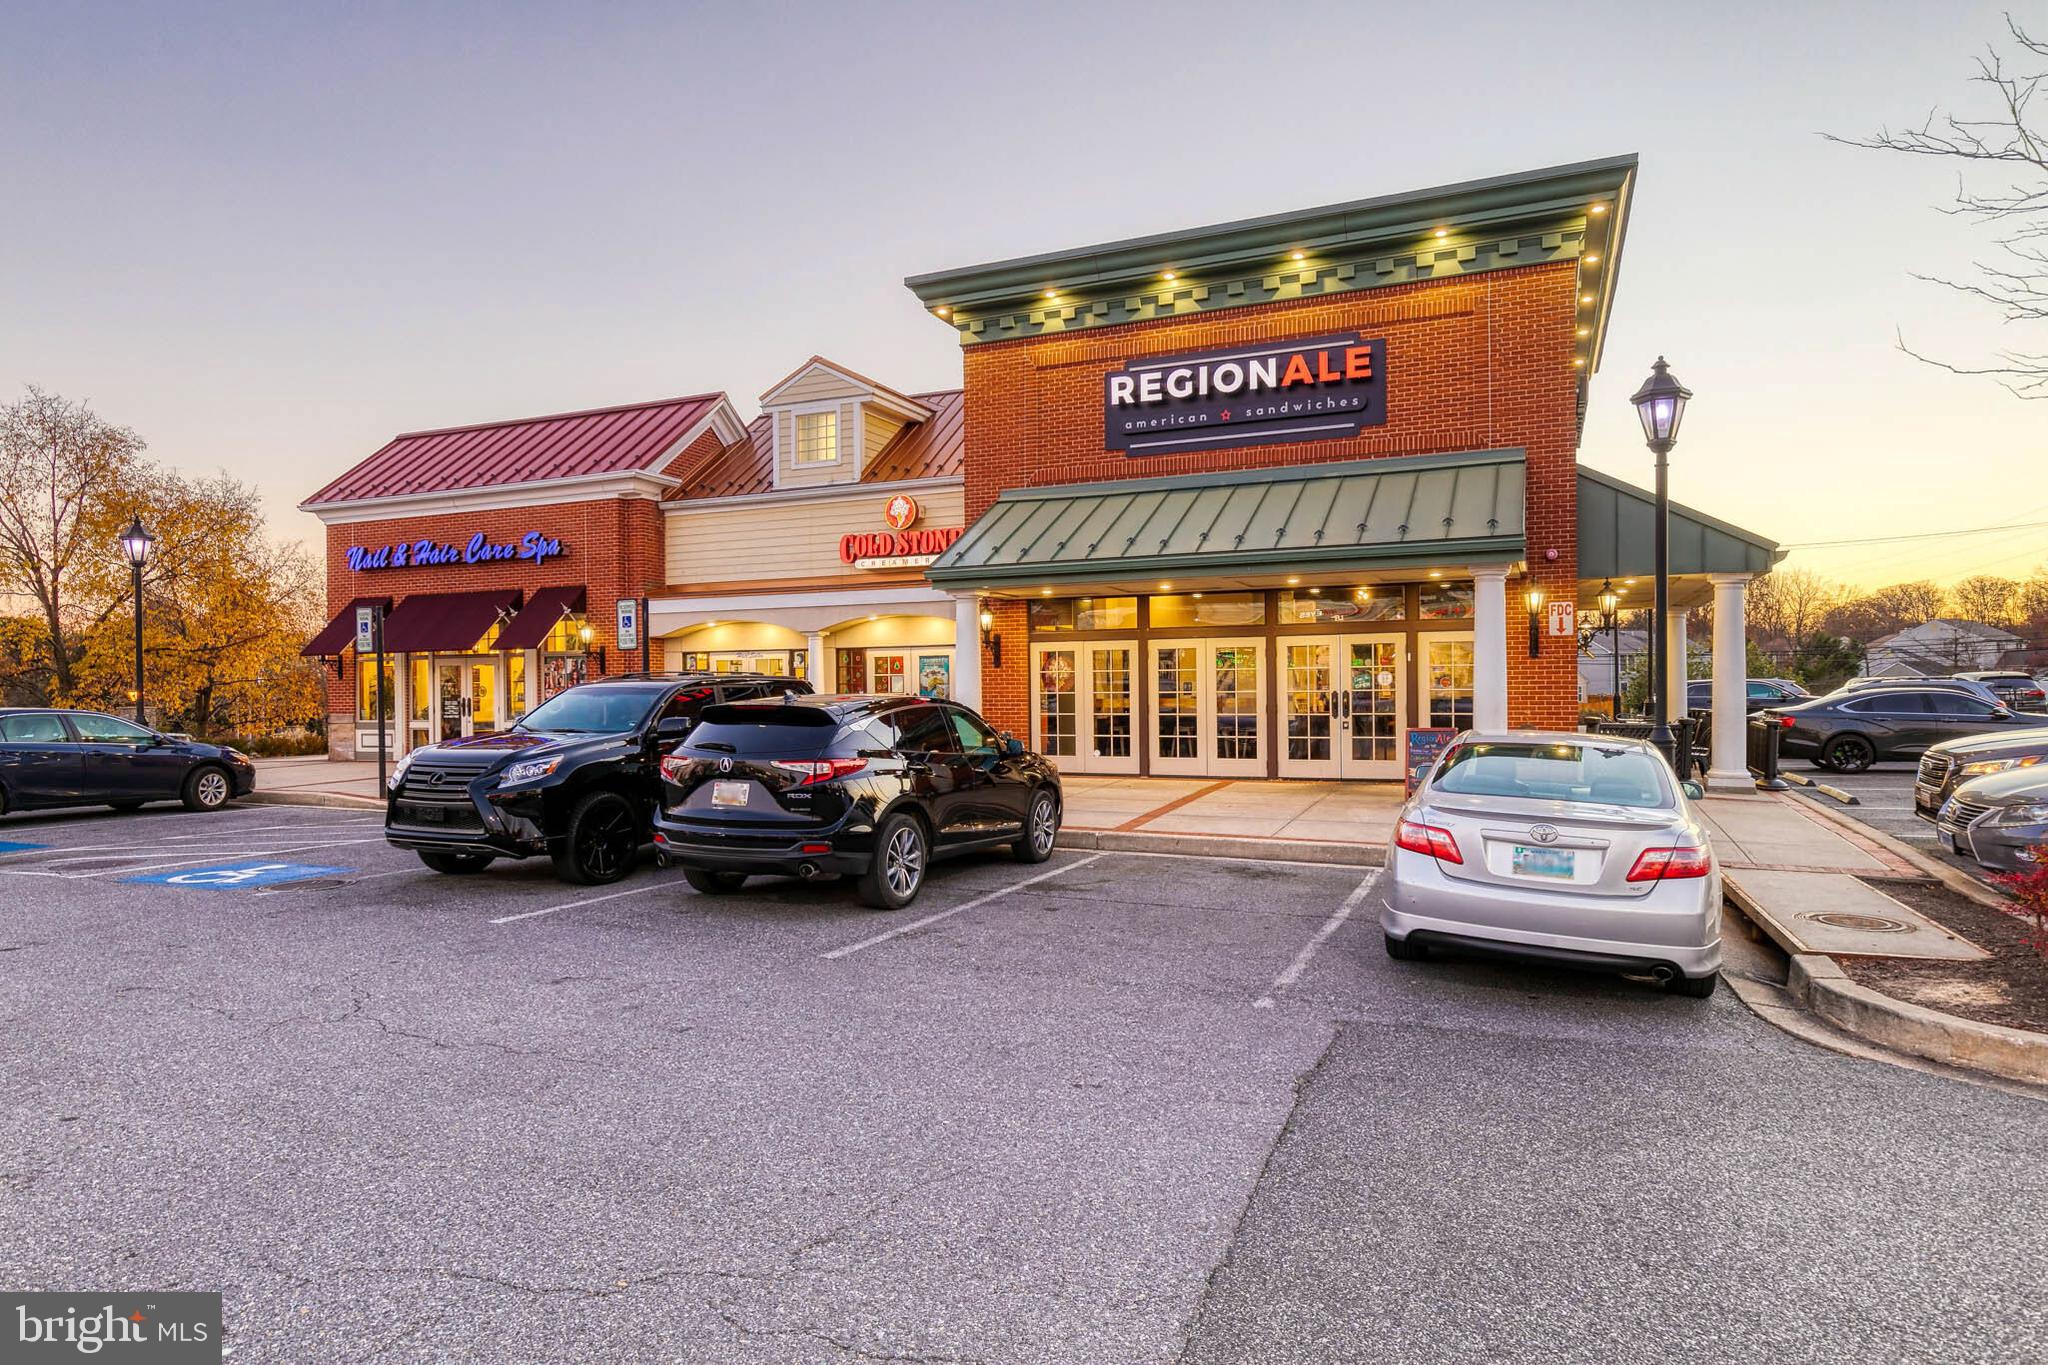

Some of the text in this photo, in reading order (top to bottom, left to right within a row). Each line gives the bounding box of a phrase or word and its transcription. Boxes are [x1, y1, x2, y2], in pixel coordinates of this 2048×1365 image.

[1110, 345, 1373, 405] REGIONALE
[1125, 395, 1360, 430] american sandwiches
[346, 530, 562, 571] Nail & Hair Care Spa
[840, 531, 894, 564] COLD
[860, 557, 930, 567] CREAMER
[1550, 604, 1572, 616] FDC
